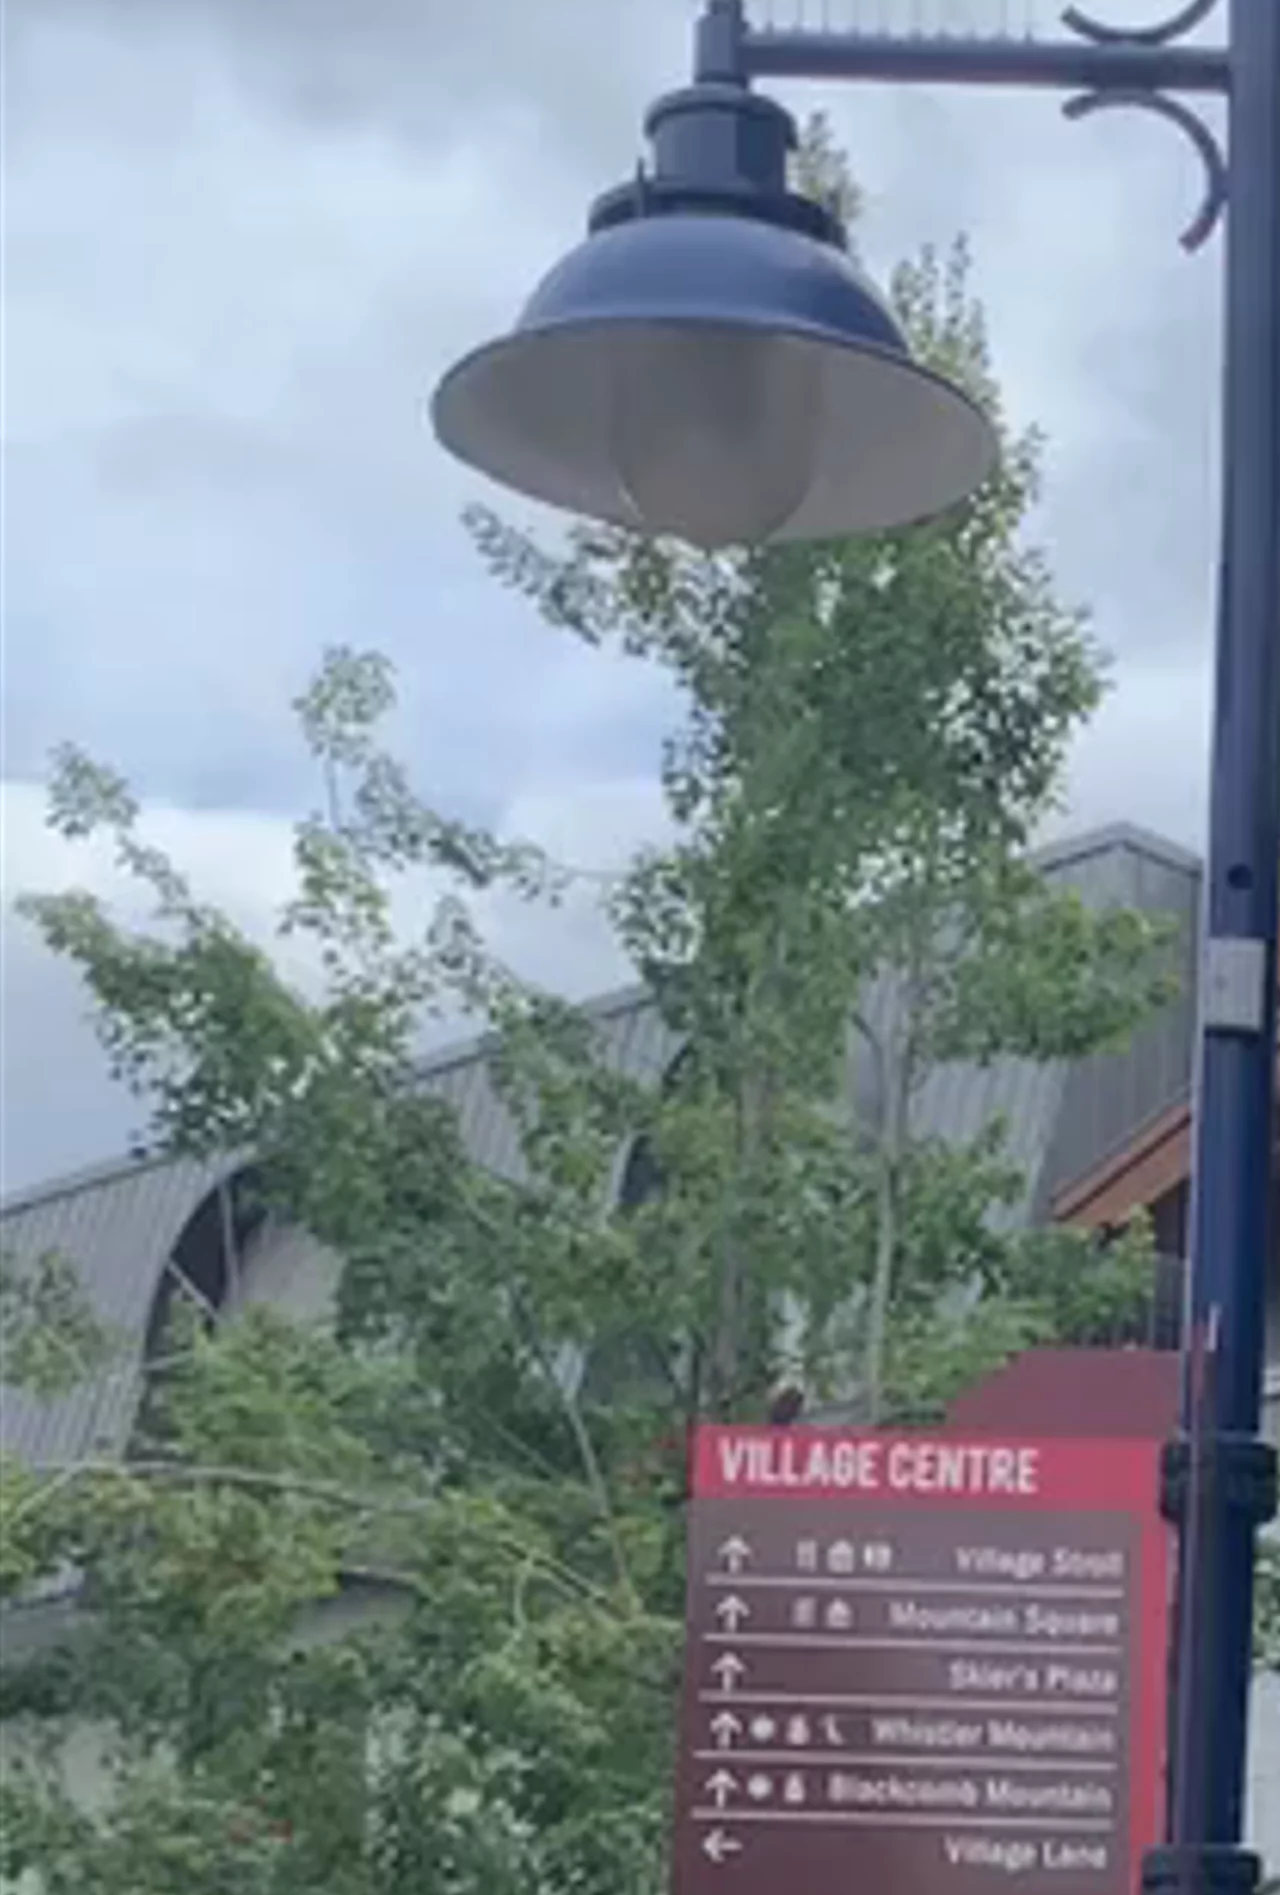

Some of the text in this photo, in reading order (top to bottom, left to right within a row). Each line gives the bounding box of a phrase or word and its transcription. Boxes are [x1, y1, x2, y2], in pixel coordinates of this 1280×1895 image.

[718, 1436, 1040, 1495] VILLAGE CENTRE
[955, 1546, 1124, 1579] Village Stroll
[889, 1601, 1119, 1636] Mountain Square
[949, 1658, 1118, 1694] Skier's Plaza
[872, 1716, 1115, 1752] Whistler Mountain
[828, 1772, 1113, 1812] Blackcomb Mountain
[944, 1834, 1107, 1873] Village Lane
